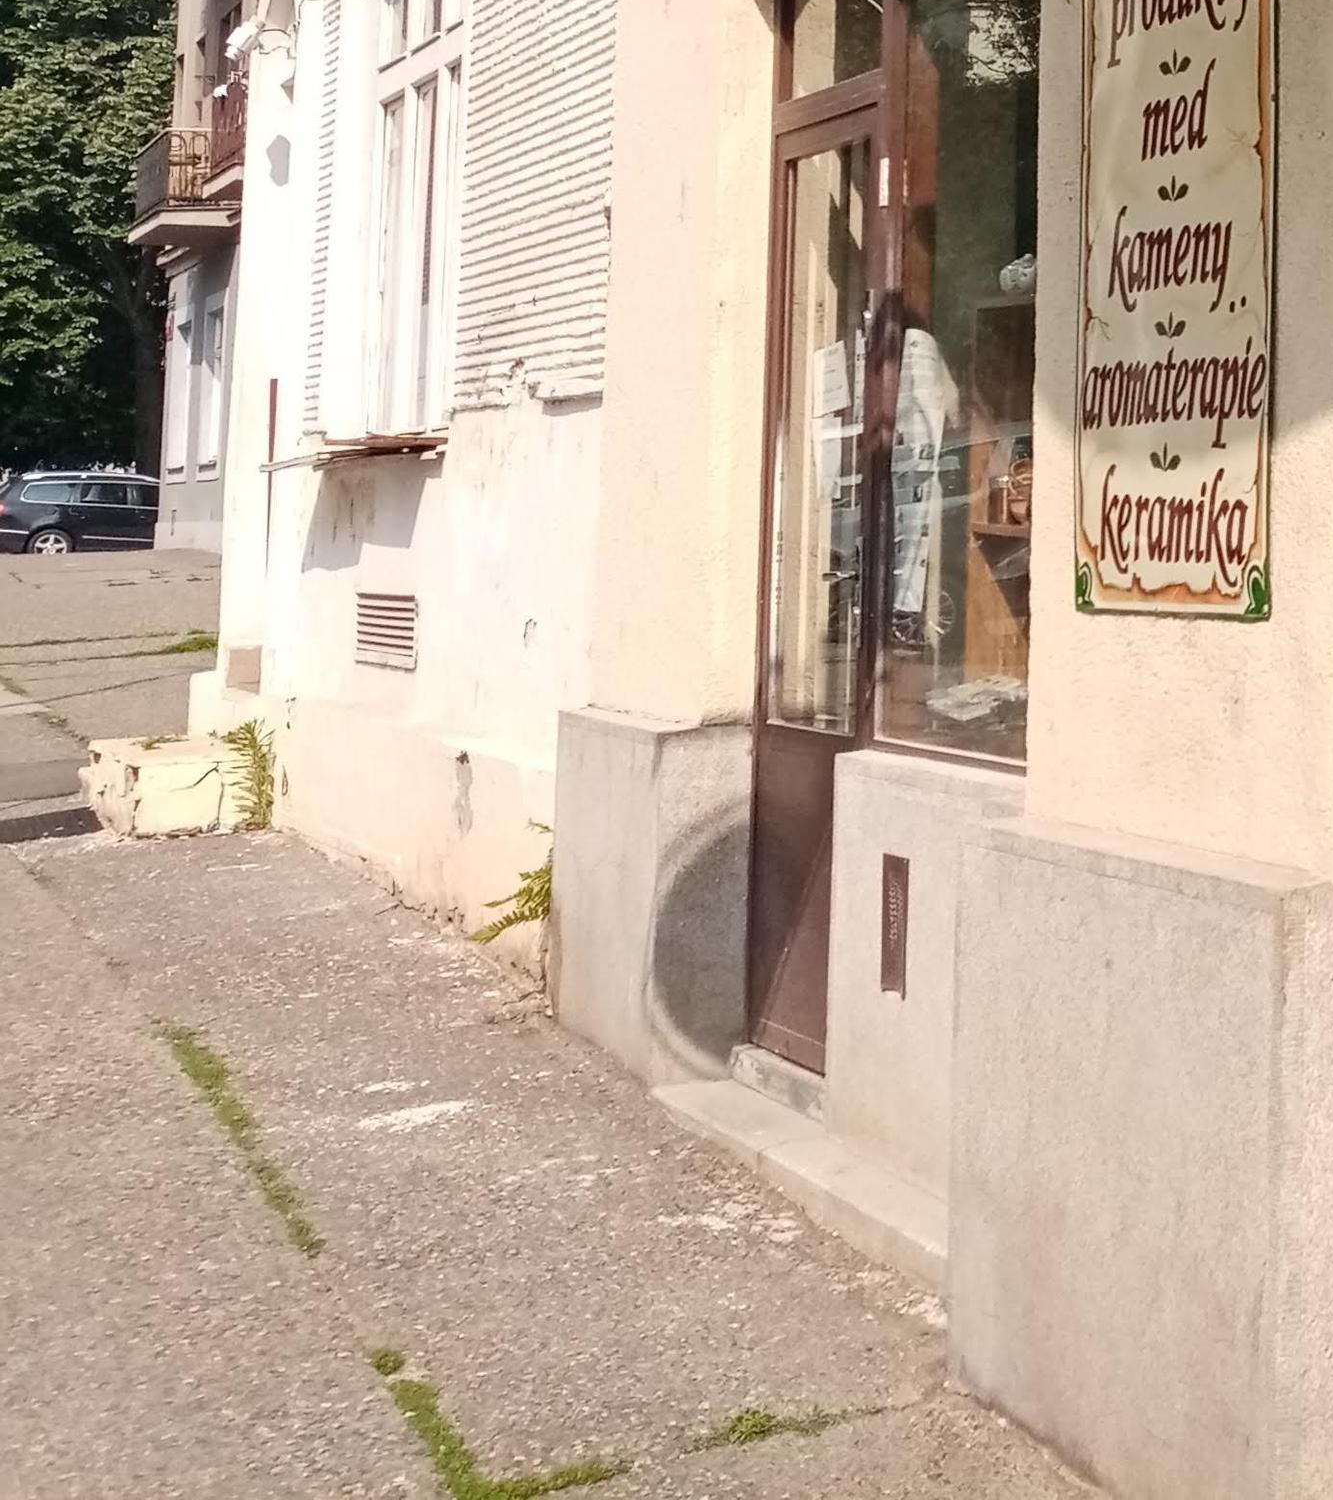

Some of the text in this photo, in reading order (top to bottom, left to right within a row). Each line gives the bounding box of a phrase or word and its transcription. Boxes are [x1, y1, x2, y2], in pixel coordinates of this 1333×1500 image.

[1142, 58, 1216, 162] med
[1082, 335, 1266, 449] aromaterapie
[1100, 464, 1248, 589] keramika
